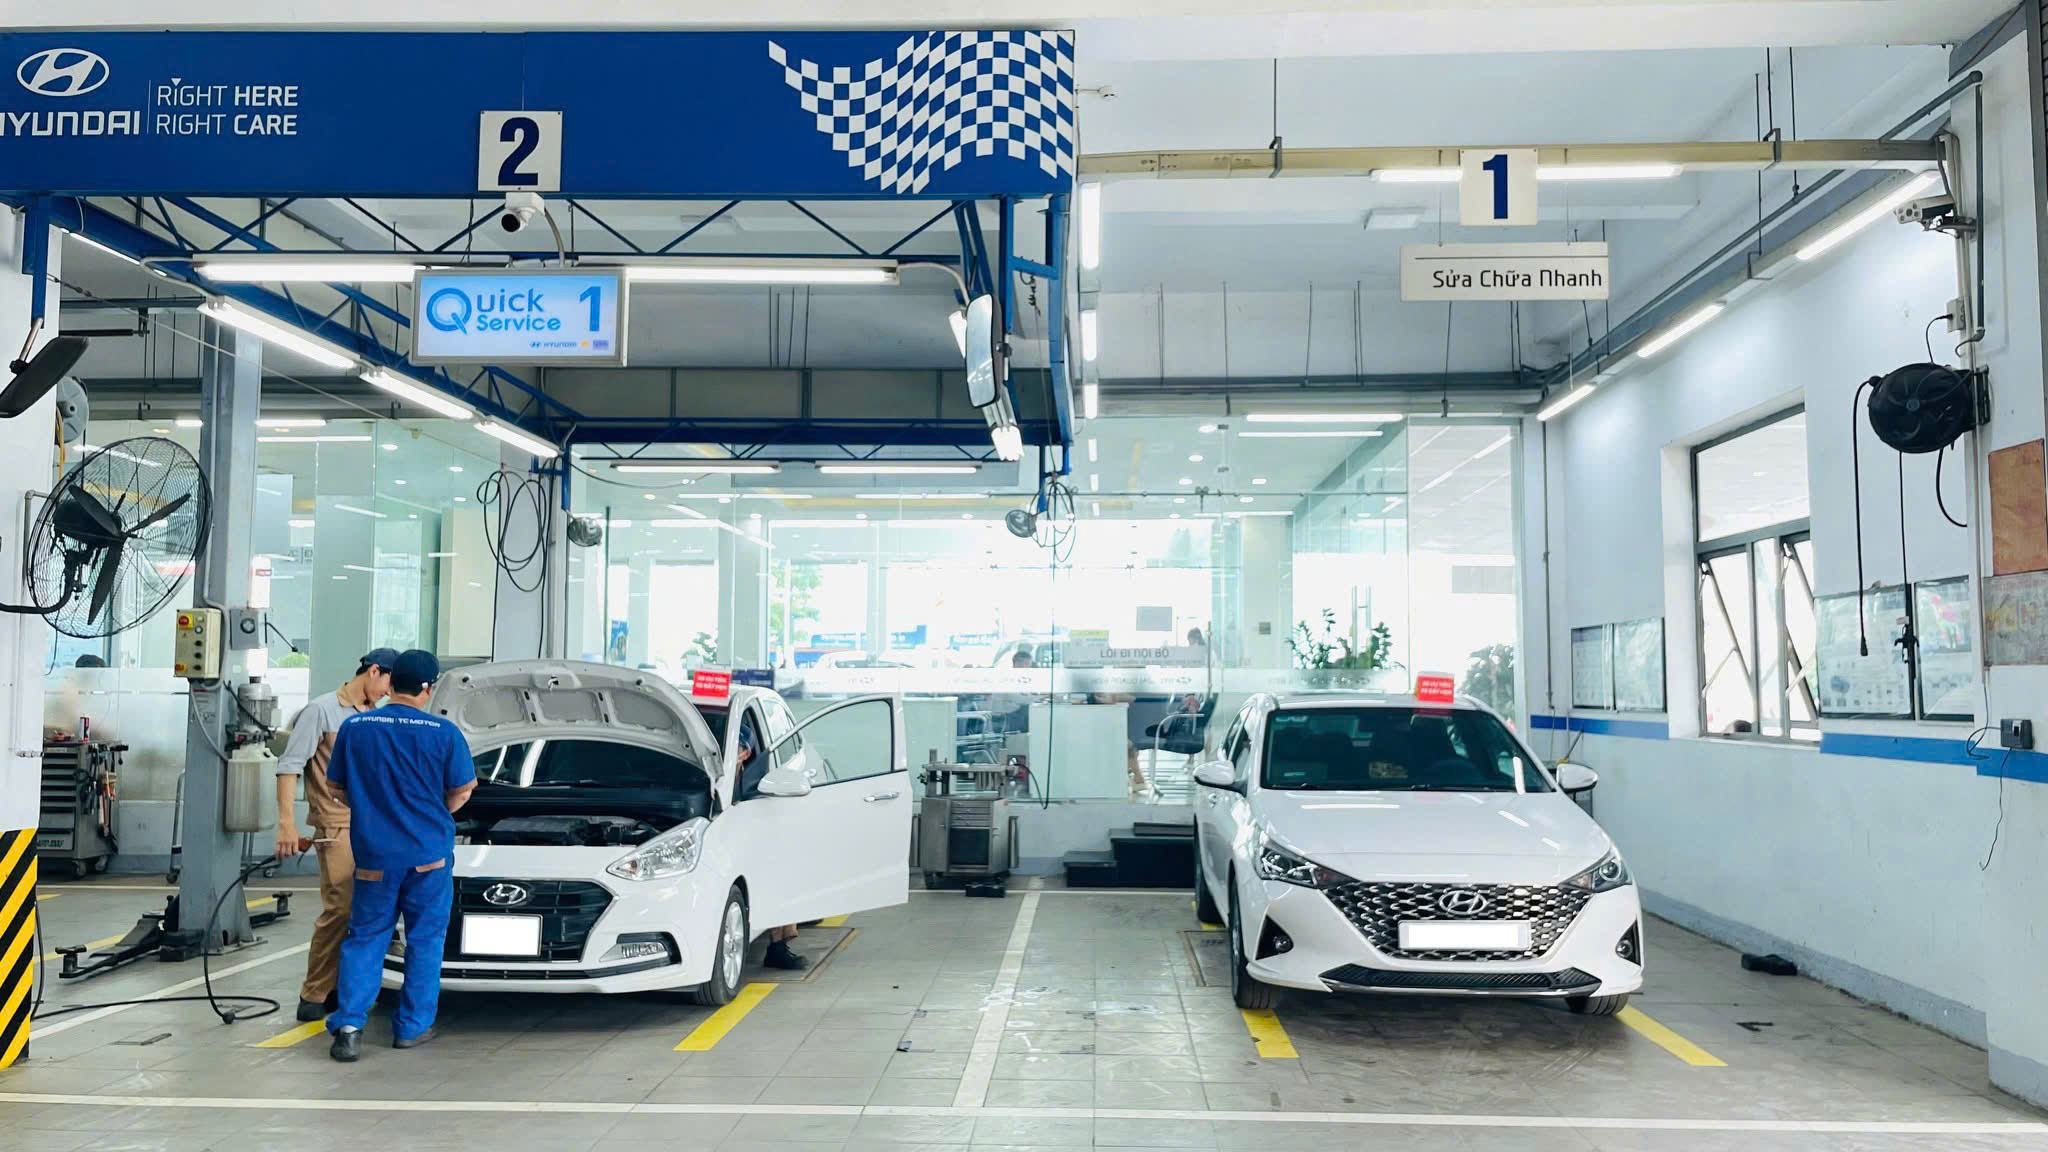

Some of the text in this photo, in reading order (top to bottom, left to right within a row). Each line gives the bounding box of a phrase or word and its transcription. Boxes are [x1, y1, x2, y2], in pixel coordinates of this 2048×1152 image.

[234, 85, 299, 107] HERE
[0, 110, 141, 136] YUNDAI
[156, 113, 298, 136] RIGHT CARE
[498, 116, 540, 186] 2
[1482, 154, 1508, 220] 1
[1432, 268, 1602, 289] Sửa Chữa Nhanh
[426, 287, 544, 335] Quick
[579, 286, 602, 332] 1
[476, 314, 561, 332] Service
[362, 716, 395, 724] HYUNDAI
[409, 718, 441, 728] MOTOR
